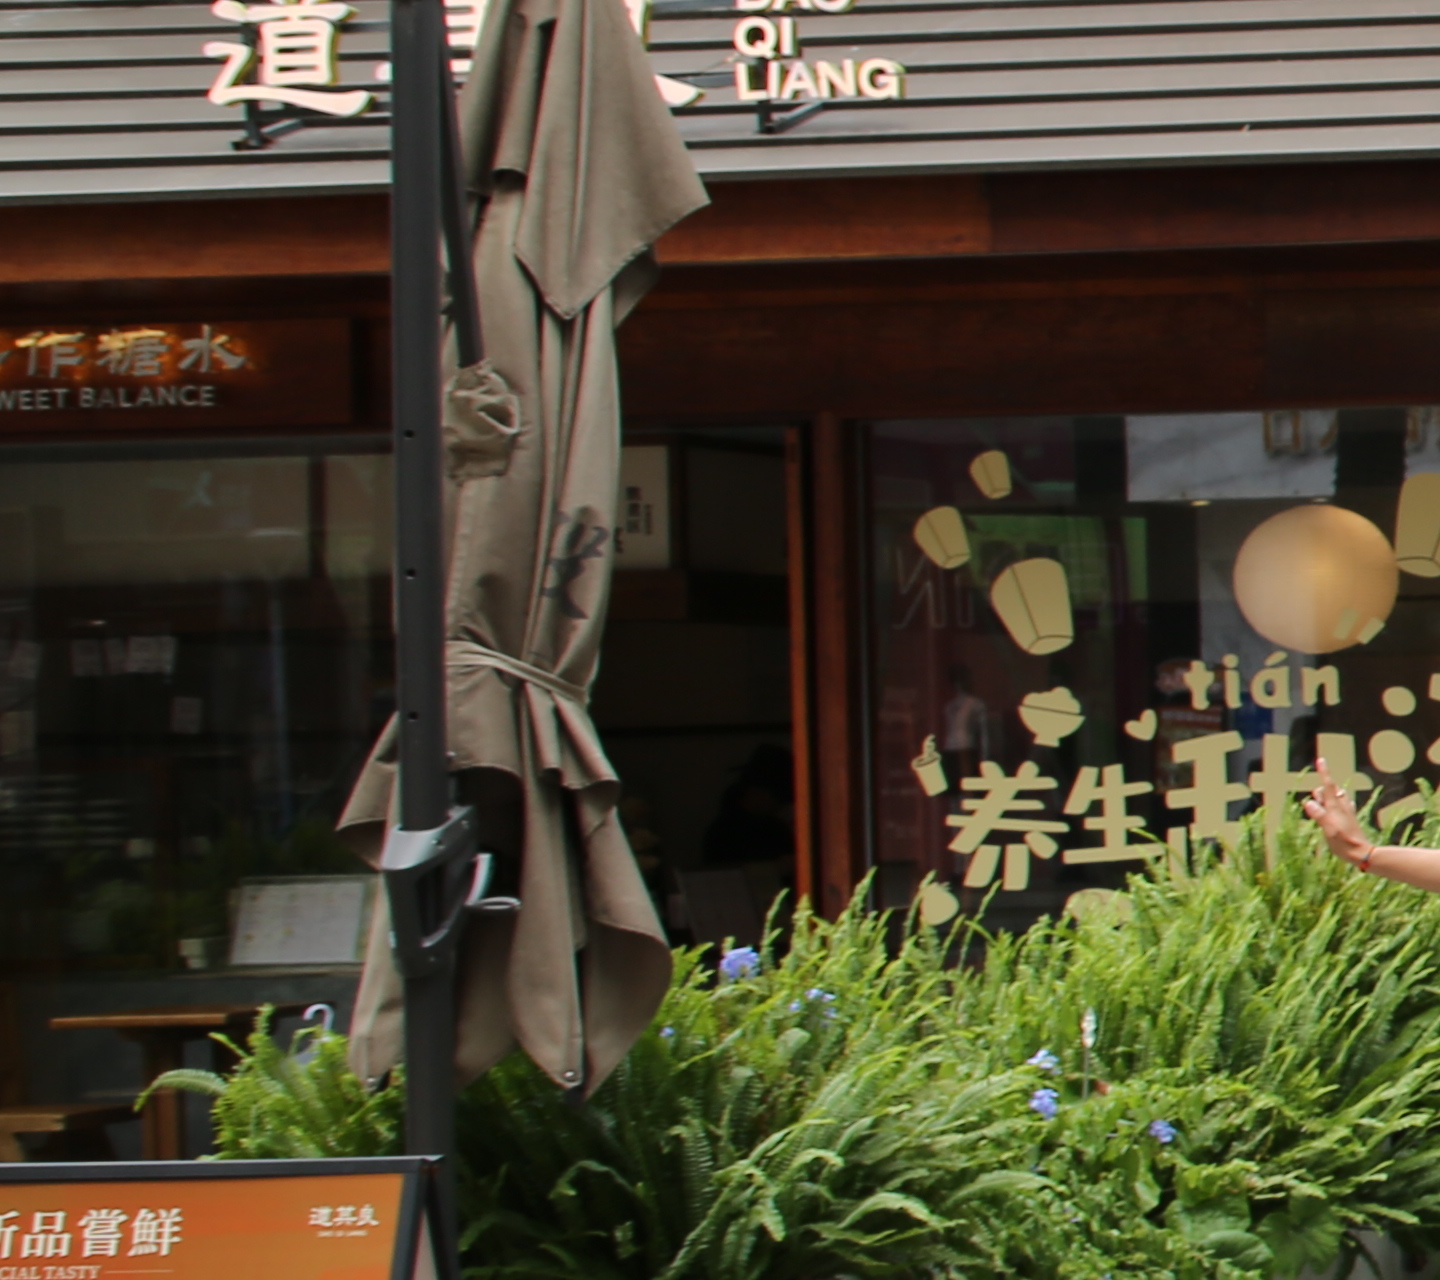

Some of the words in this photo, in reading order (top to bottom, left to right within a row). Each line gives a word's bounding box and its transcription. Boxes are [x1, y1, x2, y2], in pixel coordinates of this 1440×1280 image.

[736, 17, 796, 58] QI
[736, 59, 908, 101] LIANG
[0, 324, 248, 379] 作糖水
[79, 386, 216, 408] BALANCE
[43, 1265, 101, 1280] TASTY
